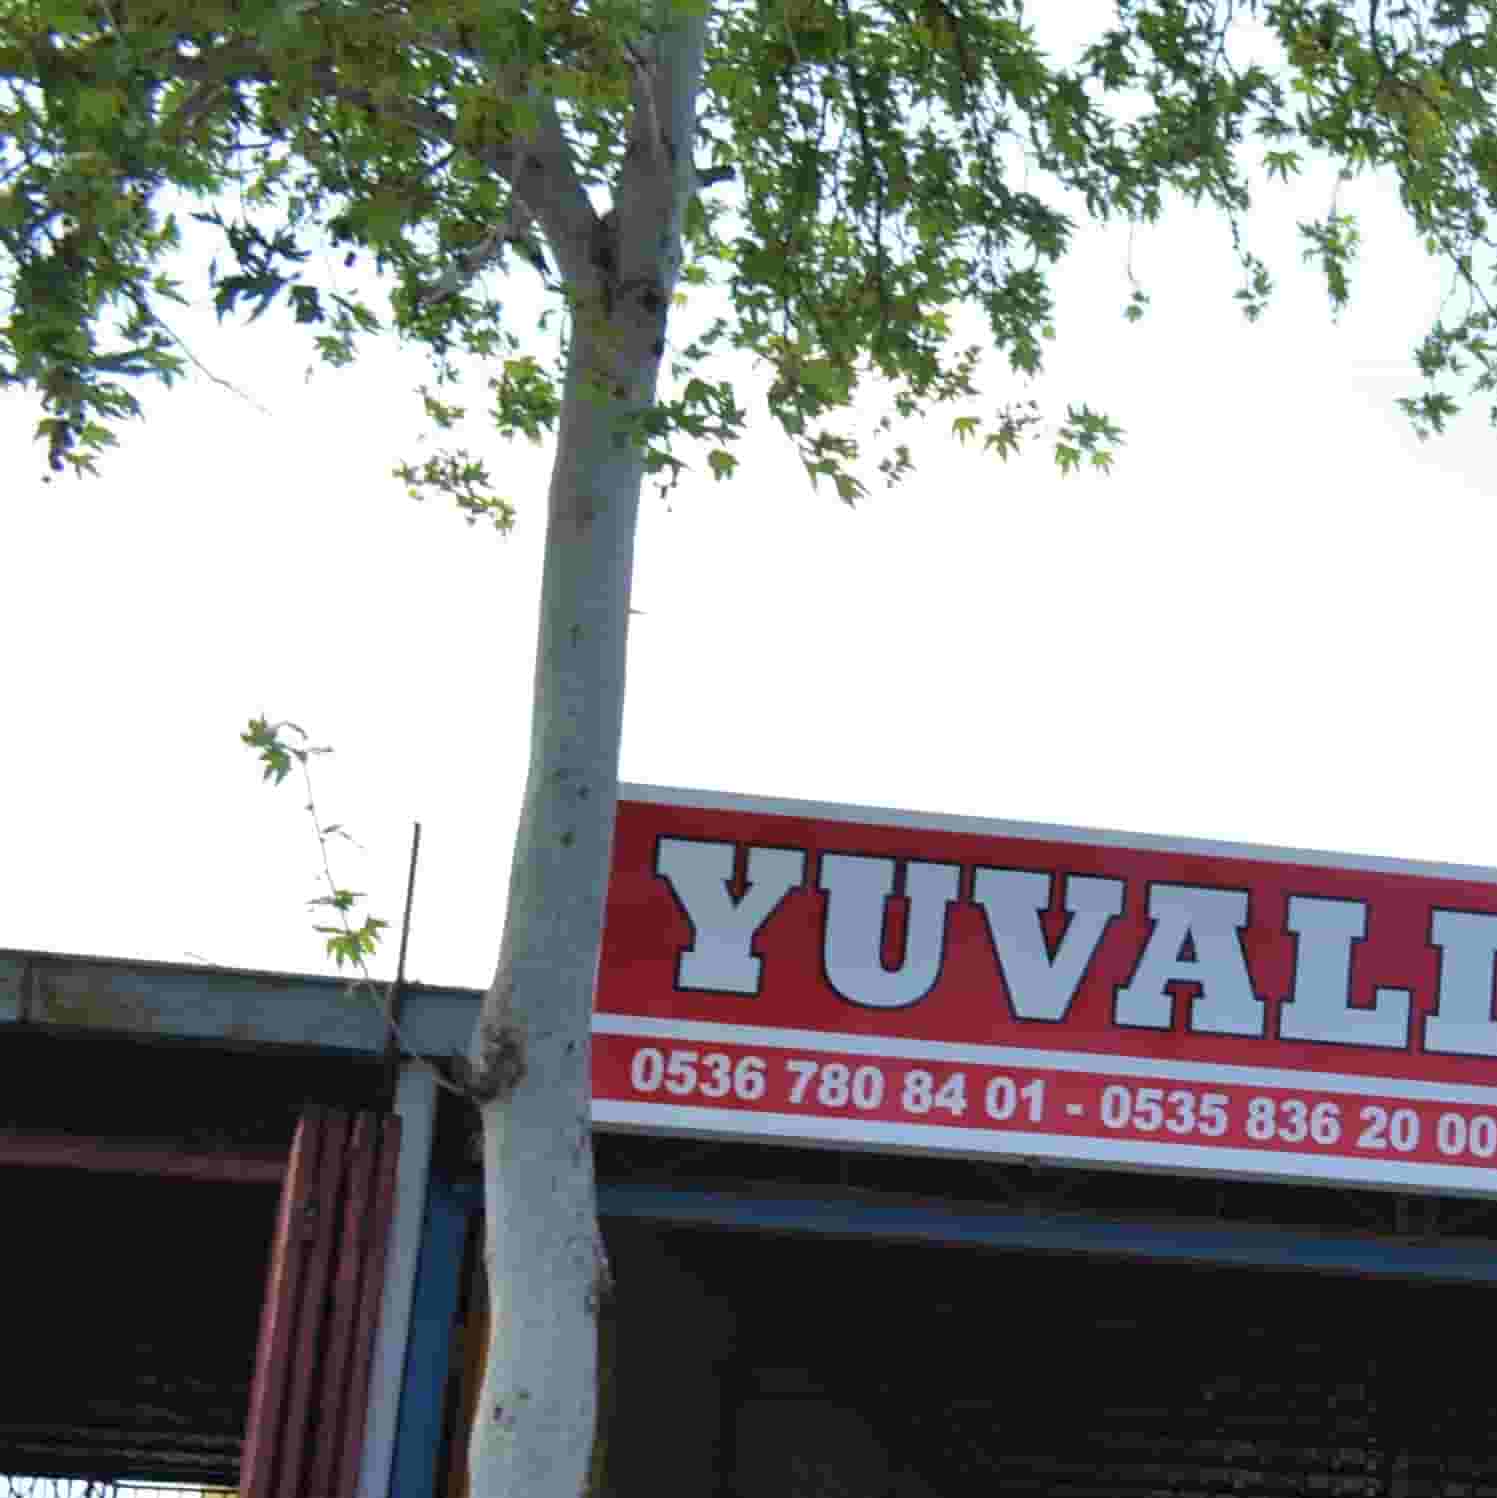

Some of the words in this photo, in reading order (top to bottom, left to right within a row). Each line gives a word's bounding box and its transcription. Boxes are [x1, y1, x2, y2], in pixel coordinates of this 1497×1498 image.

[632, 1047, 766, 1100] 0536
[786, 1059, 884, 1110] 780
[901, 1070, 968, 1116] 84
[985, 1076, 1045, 1122] 01
[1100, 1085, 1229, 1137] 0535
[1245, 1096, 1341, 1145] 836
[1356, 1105, 1420, 1152] 20
[1437, 1112, 1497, 1158] 00
